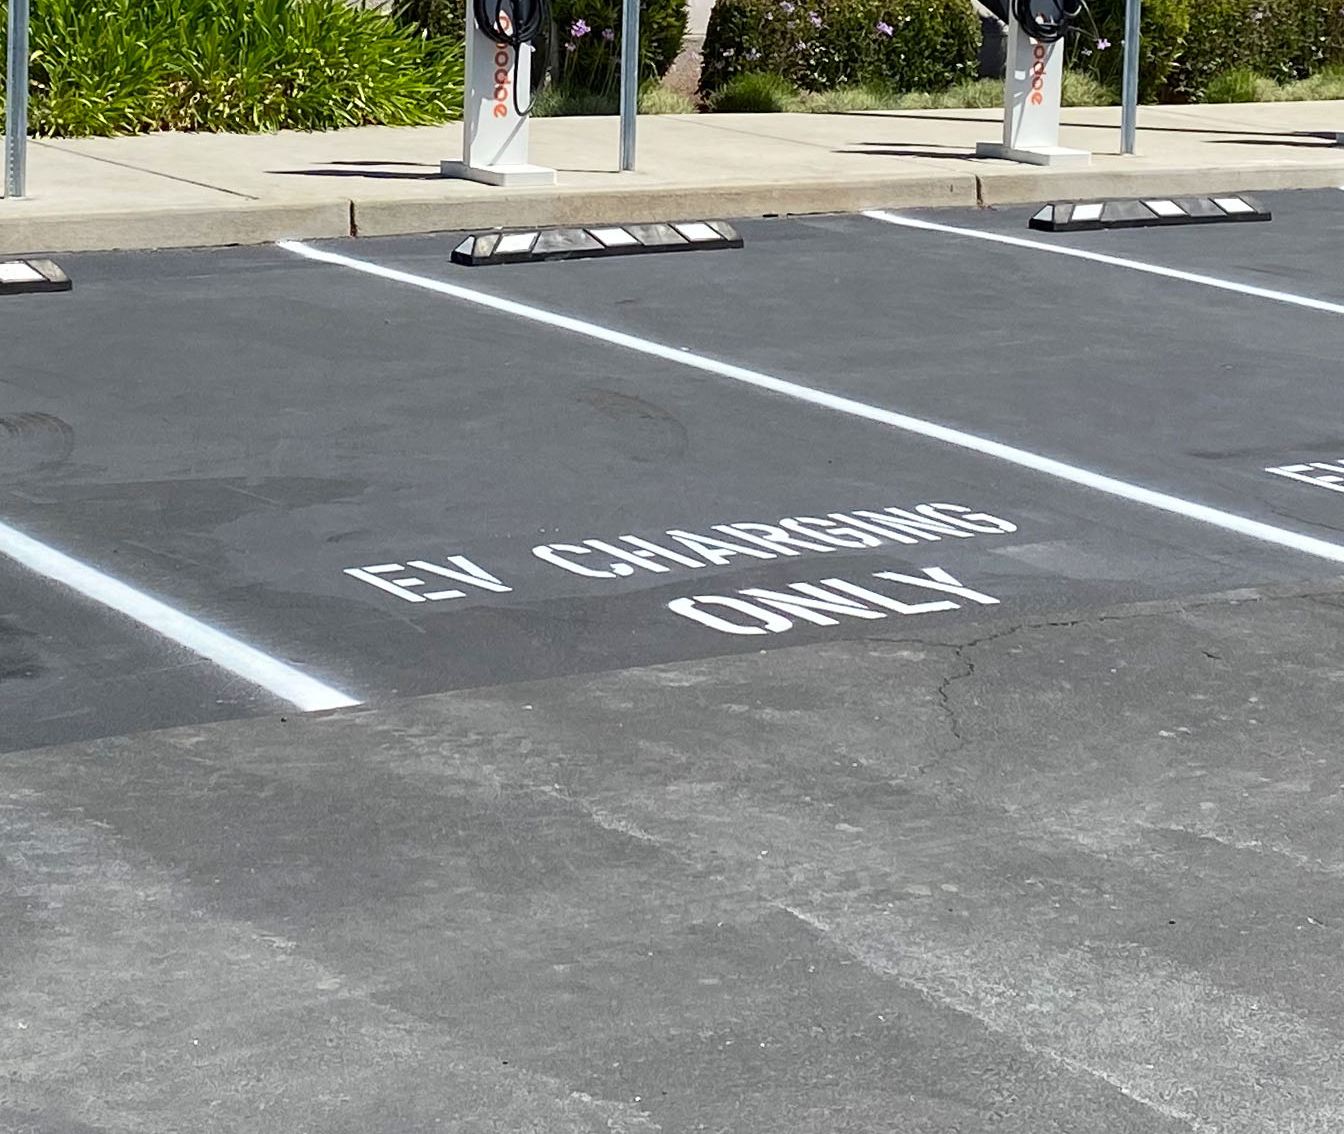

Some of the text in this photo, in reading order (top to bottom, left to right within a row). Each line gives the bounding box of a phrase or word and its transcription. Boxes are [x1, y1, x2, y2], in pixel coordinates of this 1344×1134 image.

[343, 503, 1018, 603] EV CHARGING
[667, 566, 1001, 635] ONLY
